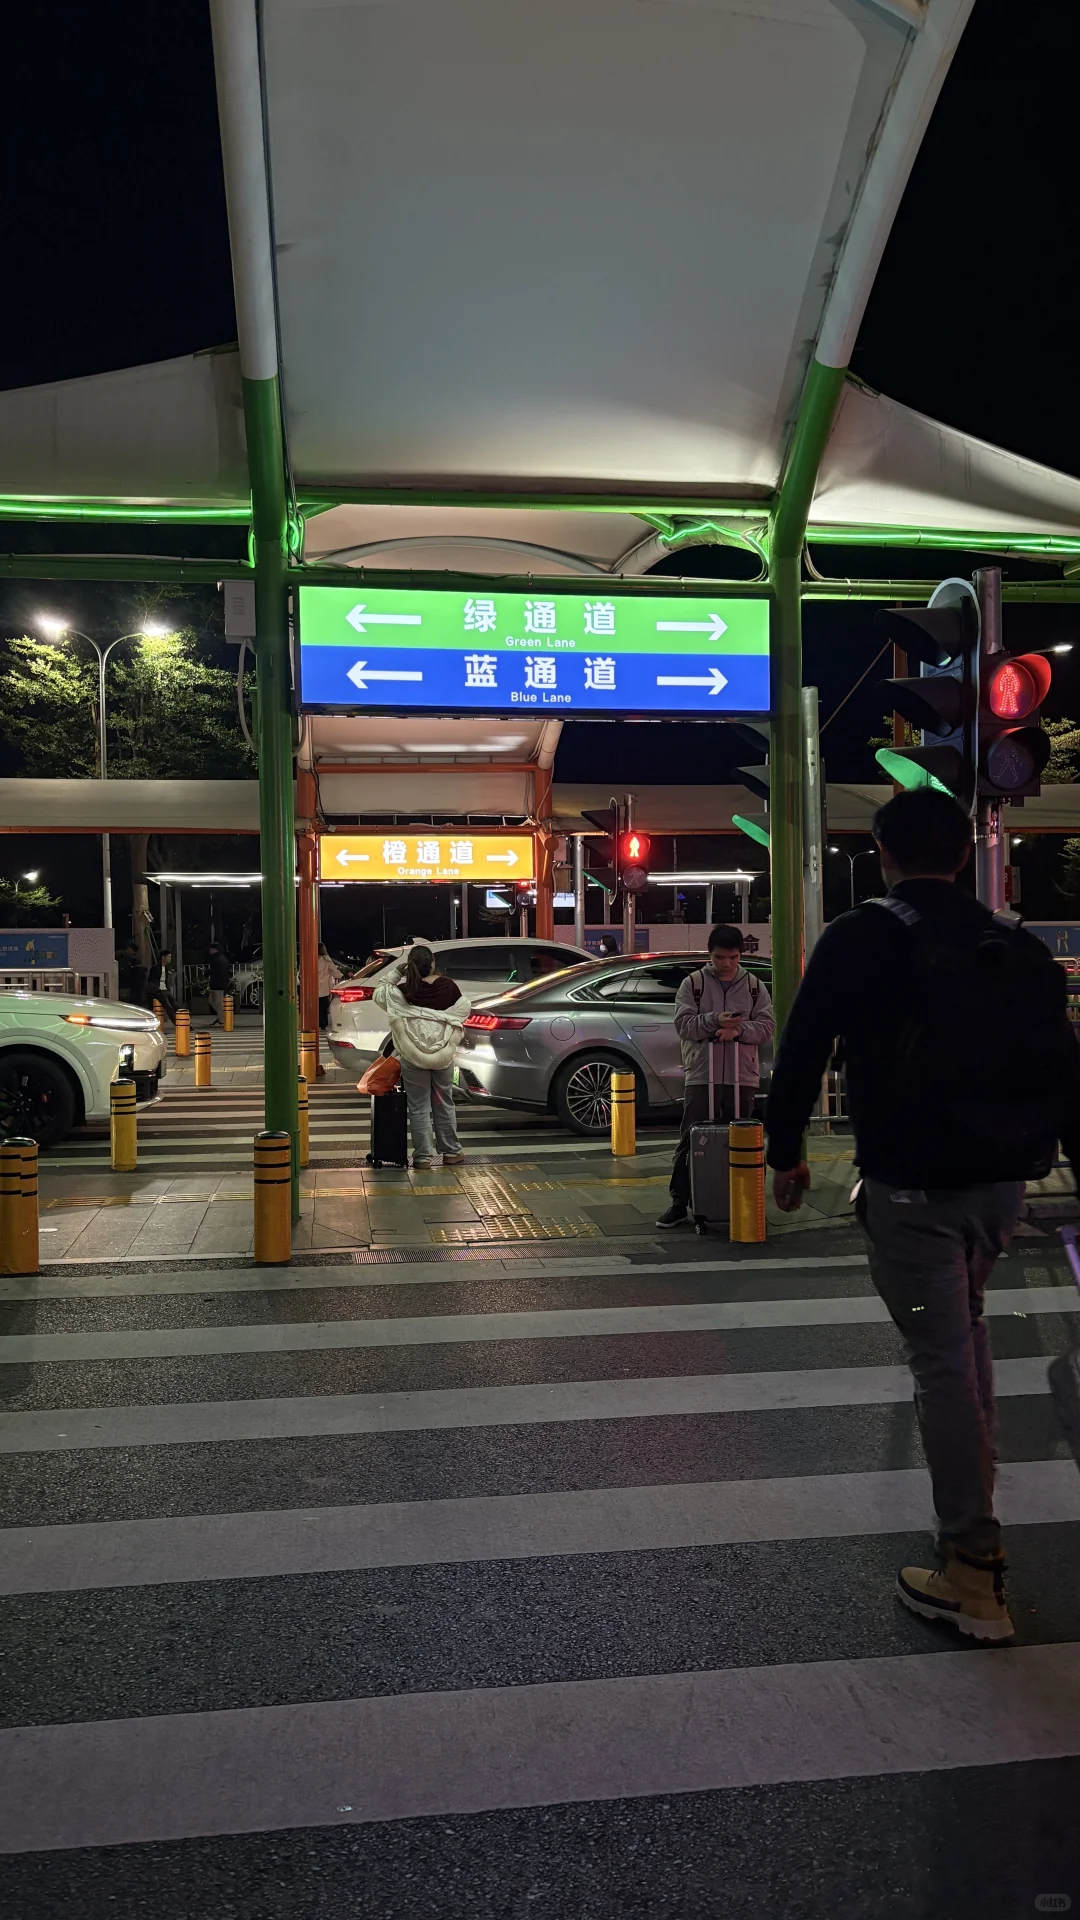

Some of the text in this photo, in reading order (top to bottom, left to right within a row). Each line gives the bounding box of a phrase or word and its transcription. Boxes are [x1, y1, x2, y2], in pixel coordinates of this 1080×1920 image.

[463, 598, 616, 635] 绿通道
[505, 636, 576, 649] Green Lane
[464, 654, 617, 690] 蓝通道
[510, 691, 572, 703] Blue Lane
[382, 839, 474, 865] 橙通道
[397, 866, 460, 877] Orange Lane
